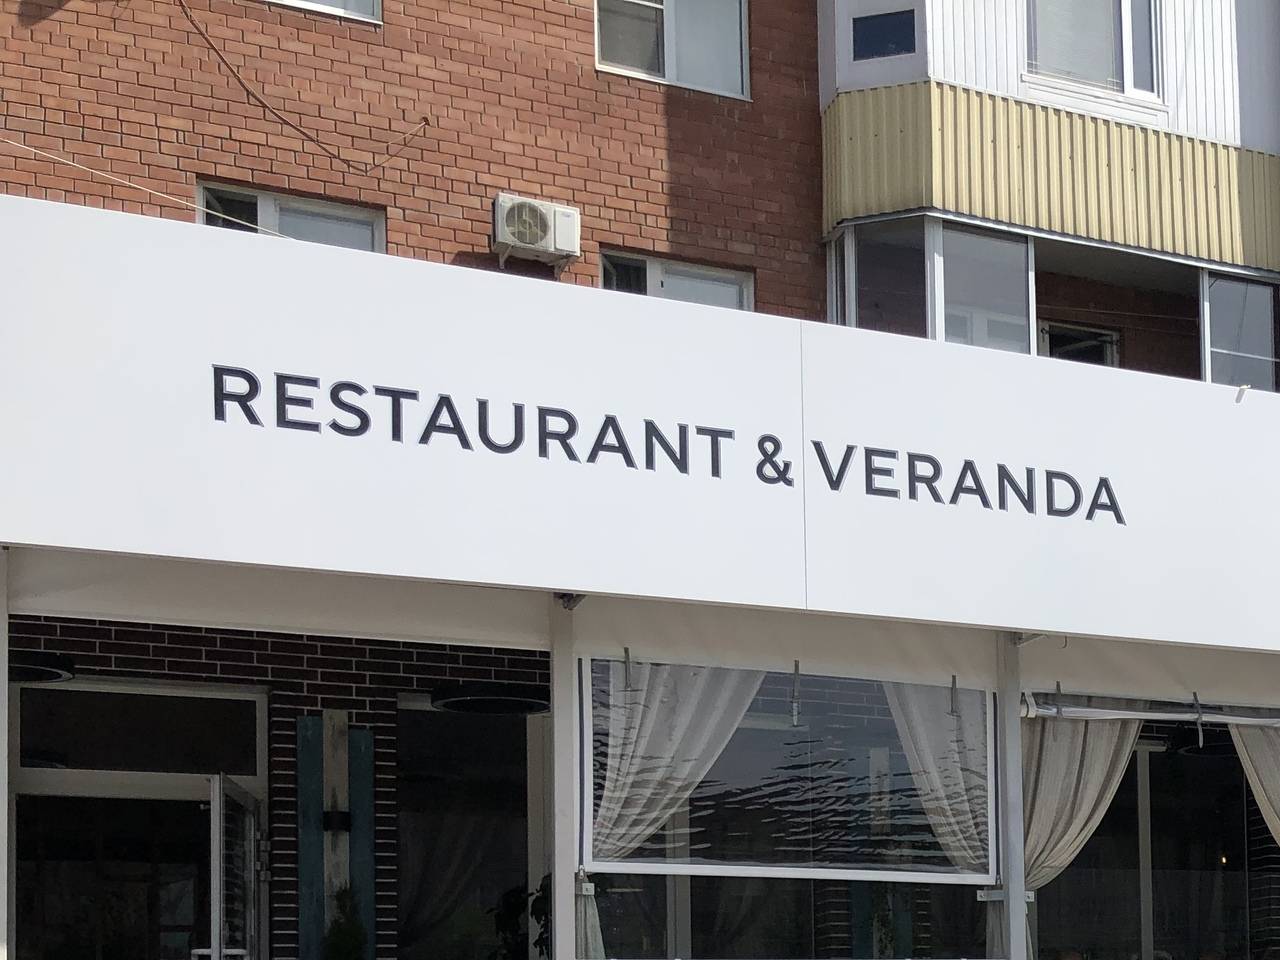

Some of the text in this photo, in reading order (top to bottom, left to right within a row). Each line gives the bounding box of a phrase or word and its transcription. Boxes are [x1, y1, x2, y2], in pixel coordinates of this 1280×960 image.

[211, 364, 1126, 526] RESTAURANT & VERANDA
